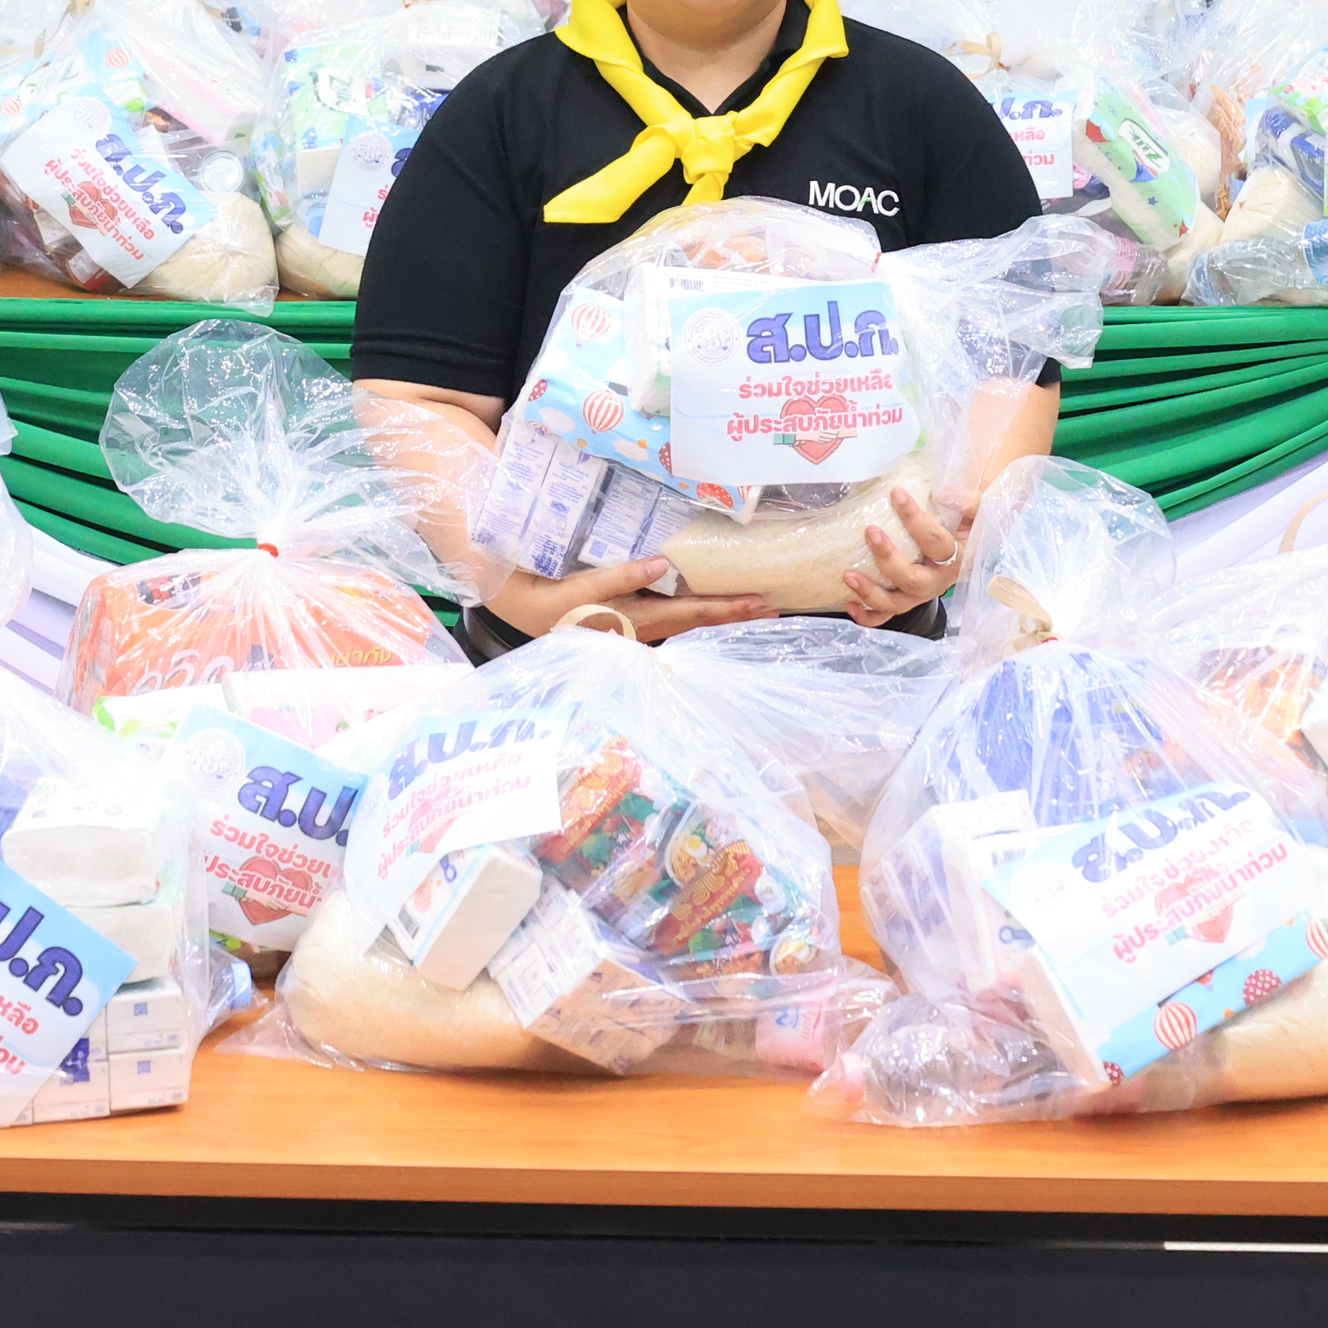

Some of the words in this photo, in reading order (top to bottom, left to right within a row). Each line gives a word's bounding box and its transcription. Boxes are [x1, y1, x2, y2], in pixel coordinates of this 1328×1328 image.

[808, 180, 900, 218] MOAC
[746, 300, 900, 364] ส.ป.ก.
[727, 399, 904, 442] ผู้ประสบภัยน้ำท่วม
[388, 718, 552, 801] ส.ป.ก.
[1112, 843, 1288, 964] ผู้ประสบภัยน้ำท่วม
